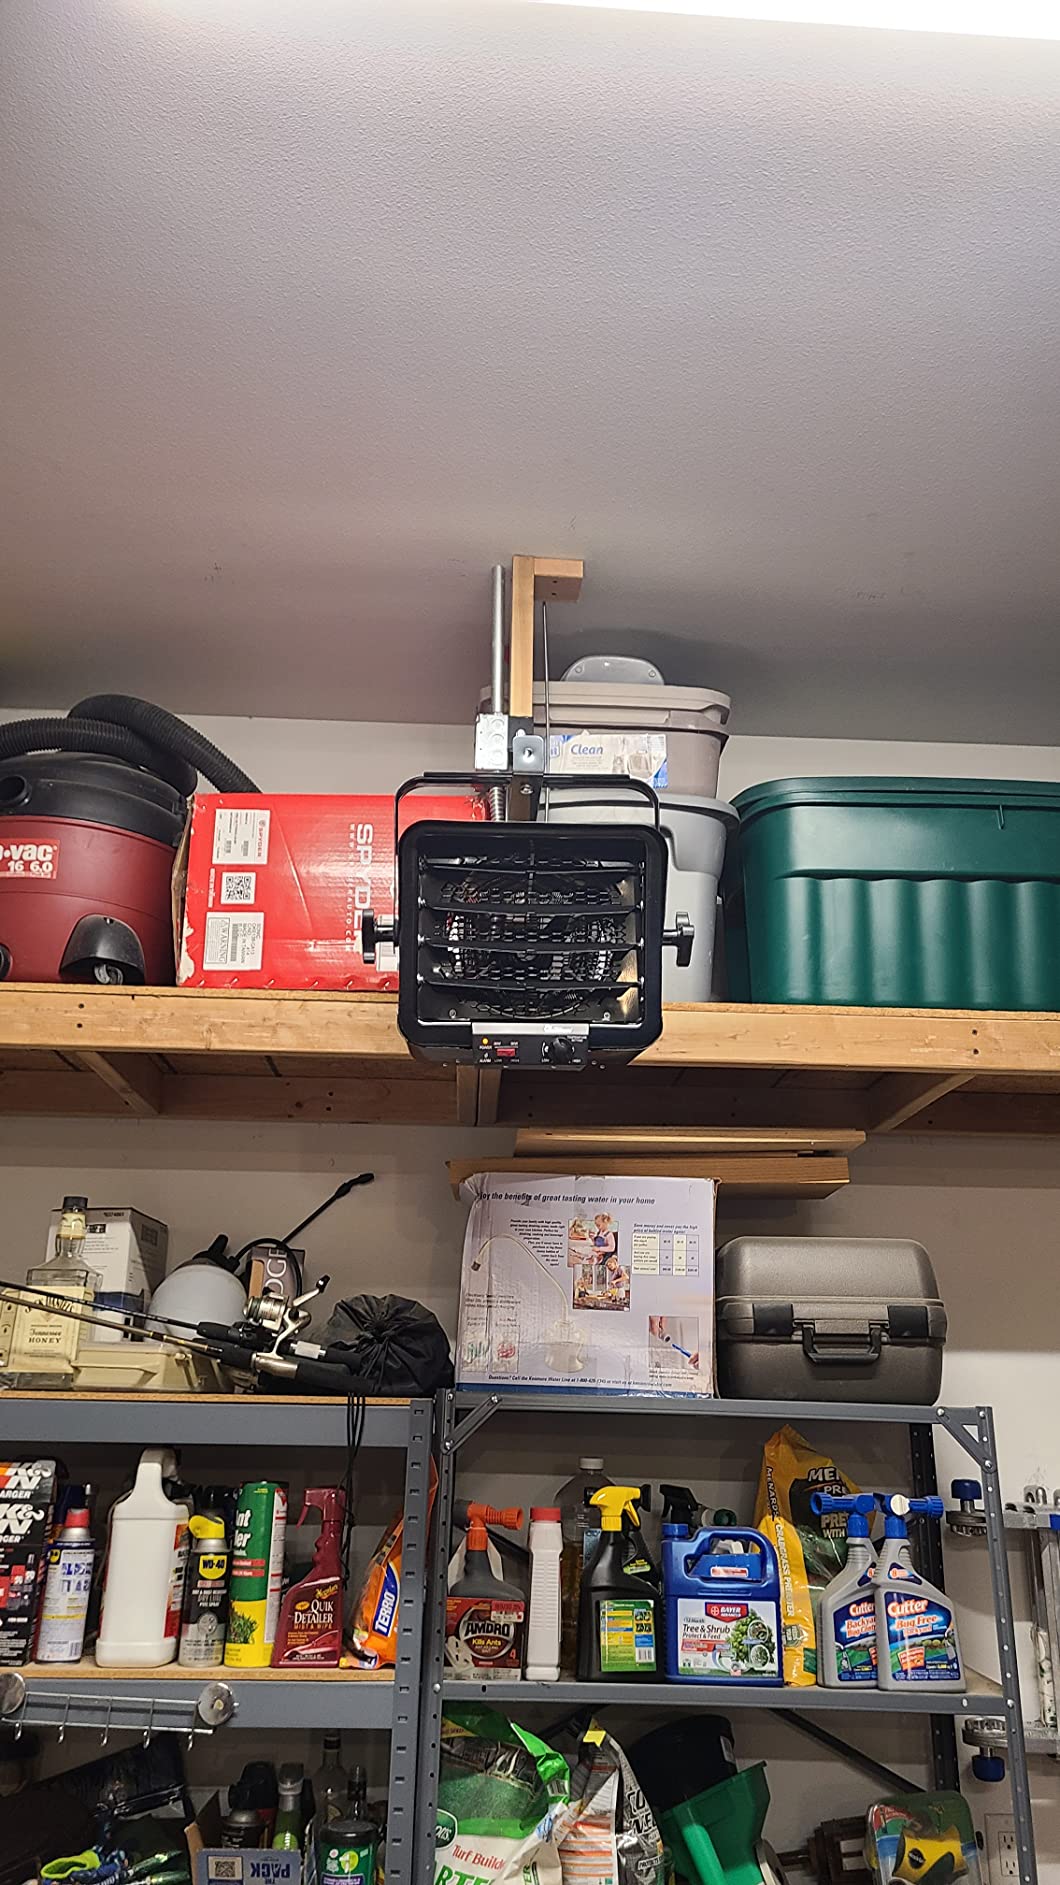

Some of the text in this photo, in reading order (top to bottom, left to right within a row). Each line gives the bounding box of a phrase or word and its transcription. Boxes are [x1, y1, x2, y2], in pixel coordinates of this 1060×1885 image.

[570, 744, 604, 755] Clean
[8, 861, 24, 873] 16
[30, 861, 53, 875] 6.0
[219, 927, 227, 961] WARNING
[479, 1192, 491, 1201] joy
[491, 1192, 503, 1200] the
[504, 1192, 532, 1201] benefits
[532, 1193, 541, 1201] of
[541, 1194, 561, 1202] great
[562, 1195, 586, 1203] tasting
[0, 1490, 31, 1499] ARGER
[234, 1529, 251, 1548] ler
[823, 1528, 846, 1538] WITH
[203, 1559, 226, 1569] WD-40
[311, 1599, 334, 1614] QUIK
[374, 1591, 396, 1633] TERRO
[887, 1599, 929, 1617] Cutter
[294, 1611, 334, 1624] DETAILER
[895, 1615, 938, 1630] Bug Free
[464, 1622, 511, 1636] AMDRO
[683, 1624, 700, 1632] Tree
[706, 1625, 731, 1634] Shrub
[510, 1649, 517, 1659] 4
[452, 1844, 472, 1863] Turf
[250, 1863, 291, 1876] PACK
